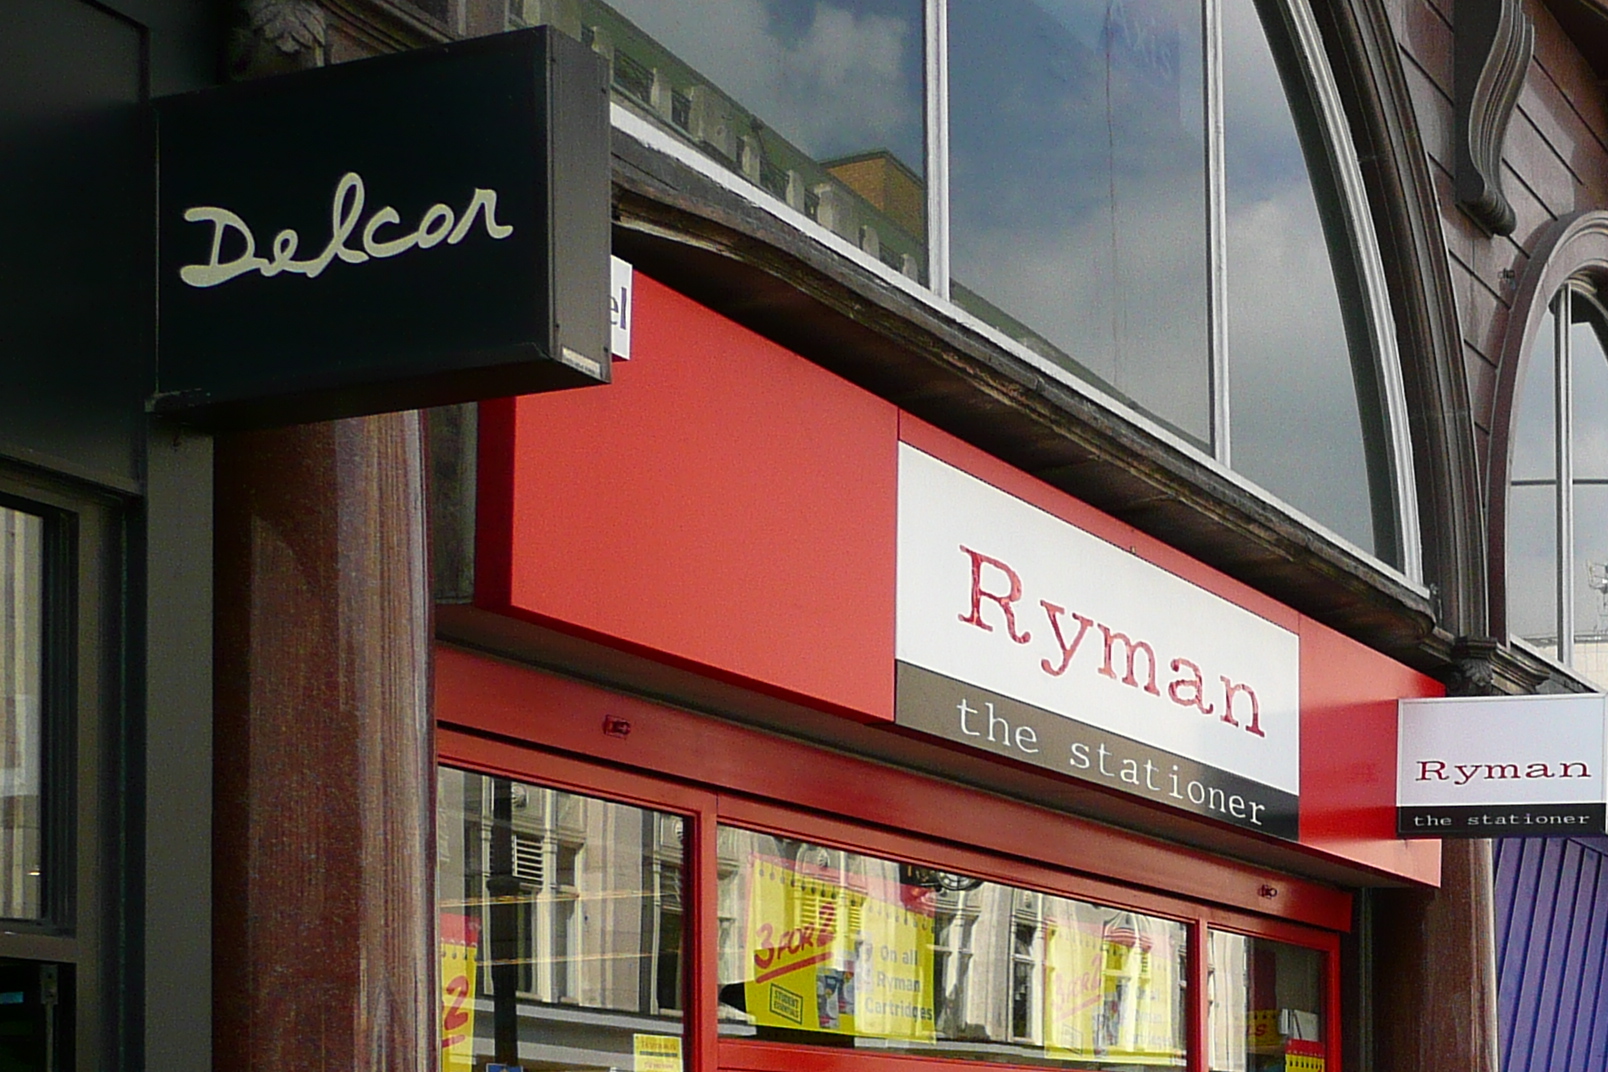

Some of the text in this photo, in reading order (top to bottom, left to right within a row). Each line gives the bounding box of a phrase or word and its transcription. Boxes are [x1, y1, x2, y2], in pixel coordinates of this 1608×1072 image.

[179, 171, 513, 288] Delcor
[957, 544, 1266, 739] Ryman
[956, 696, 1266, 827] the stationer
[1415, 759, 1591, 782] Ryman
[1413, 811, 1590, 828] the stationer
[753, 923, 775, 969] 3
[901, 947, 918, 967] all
